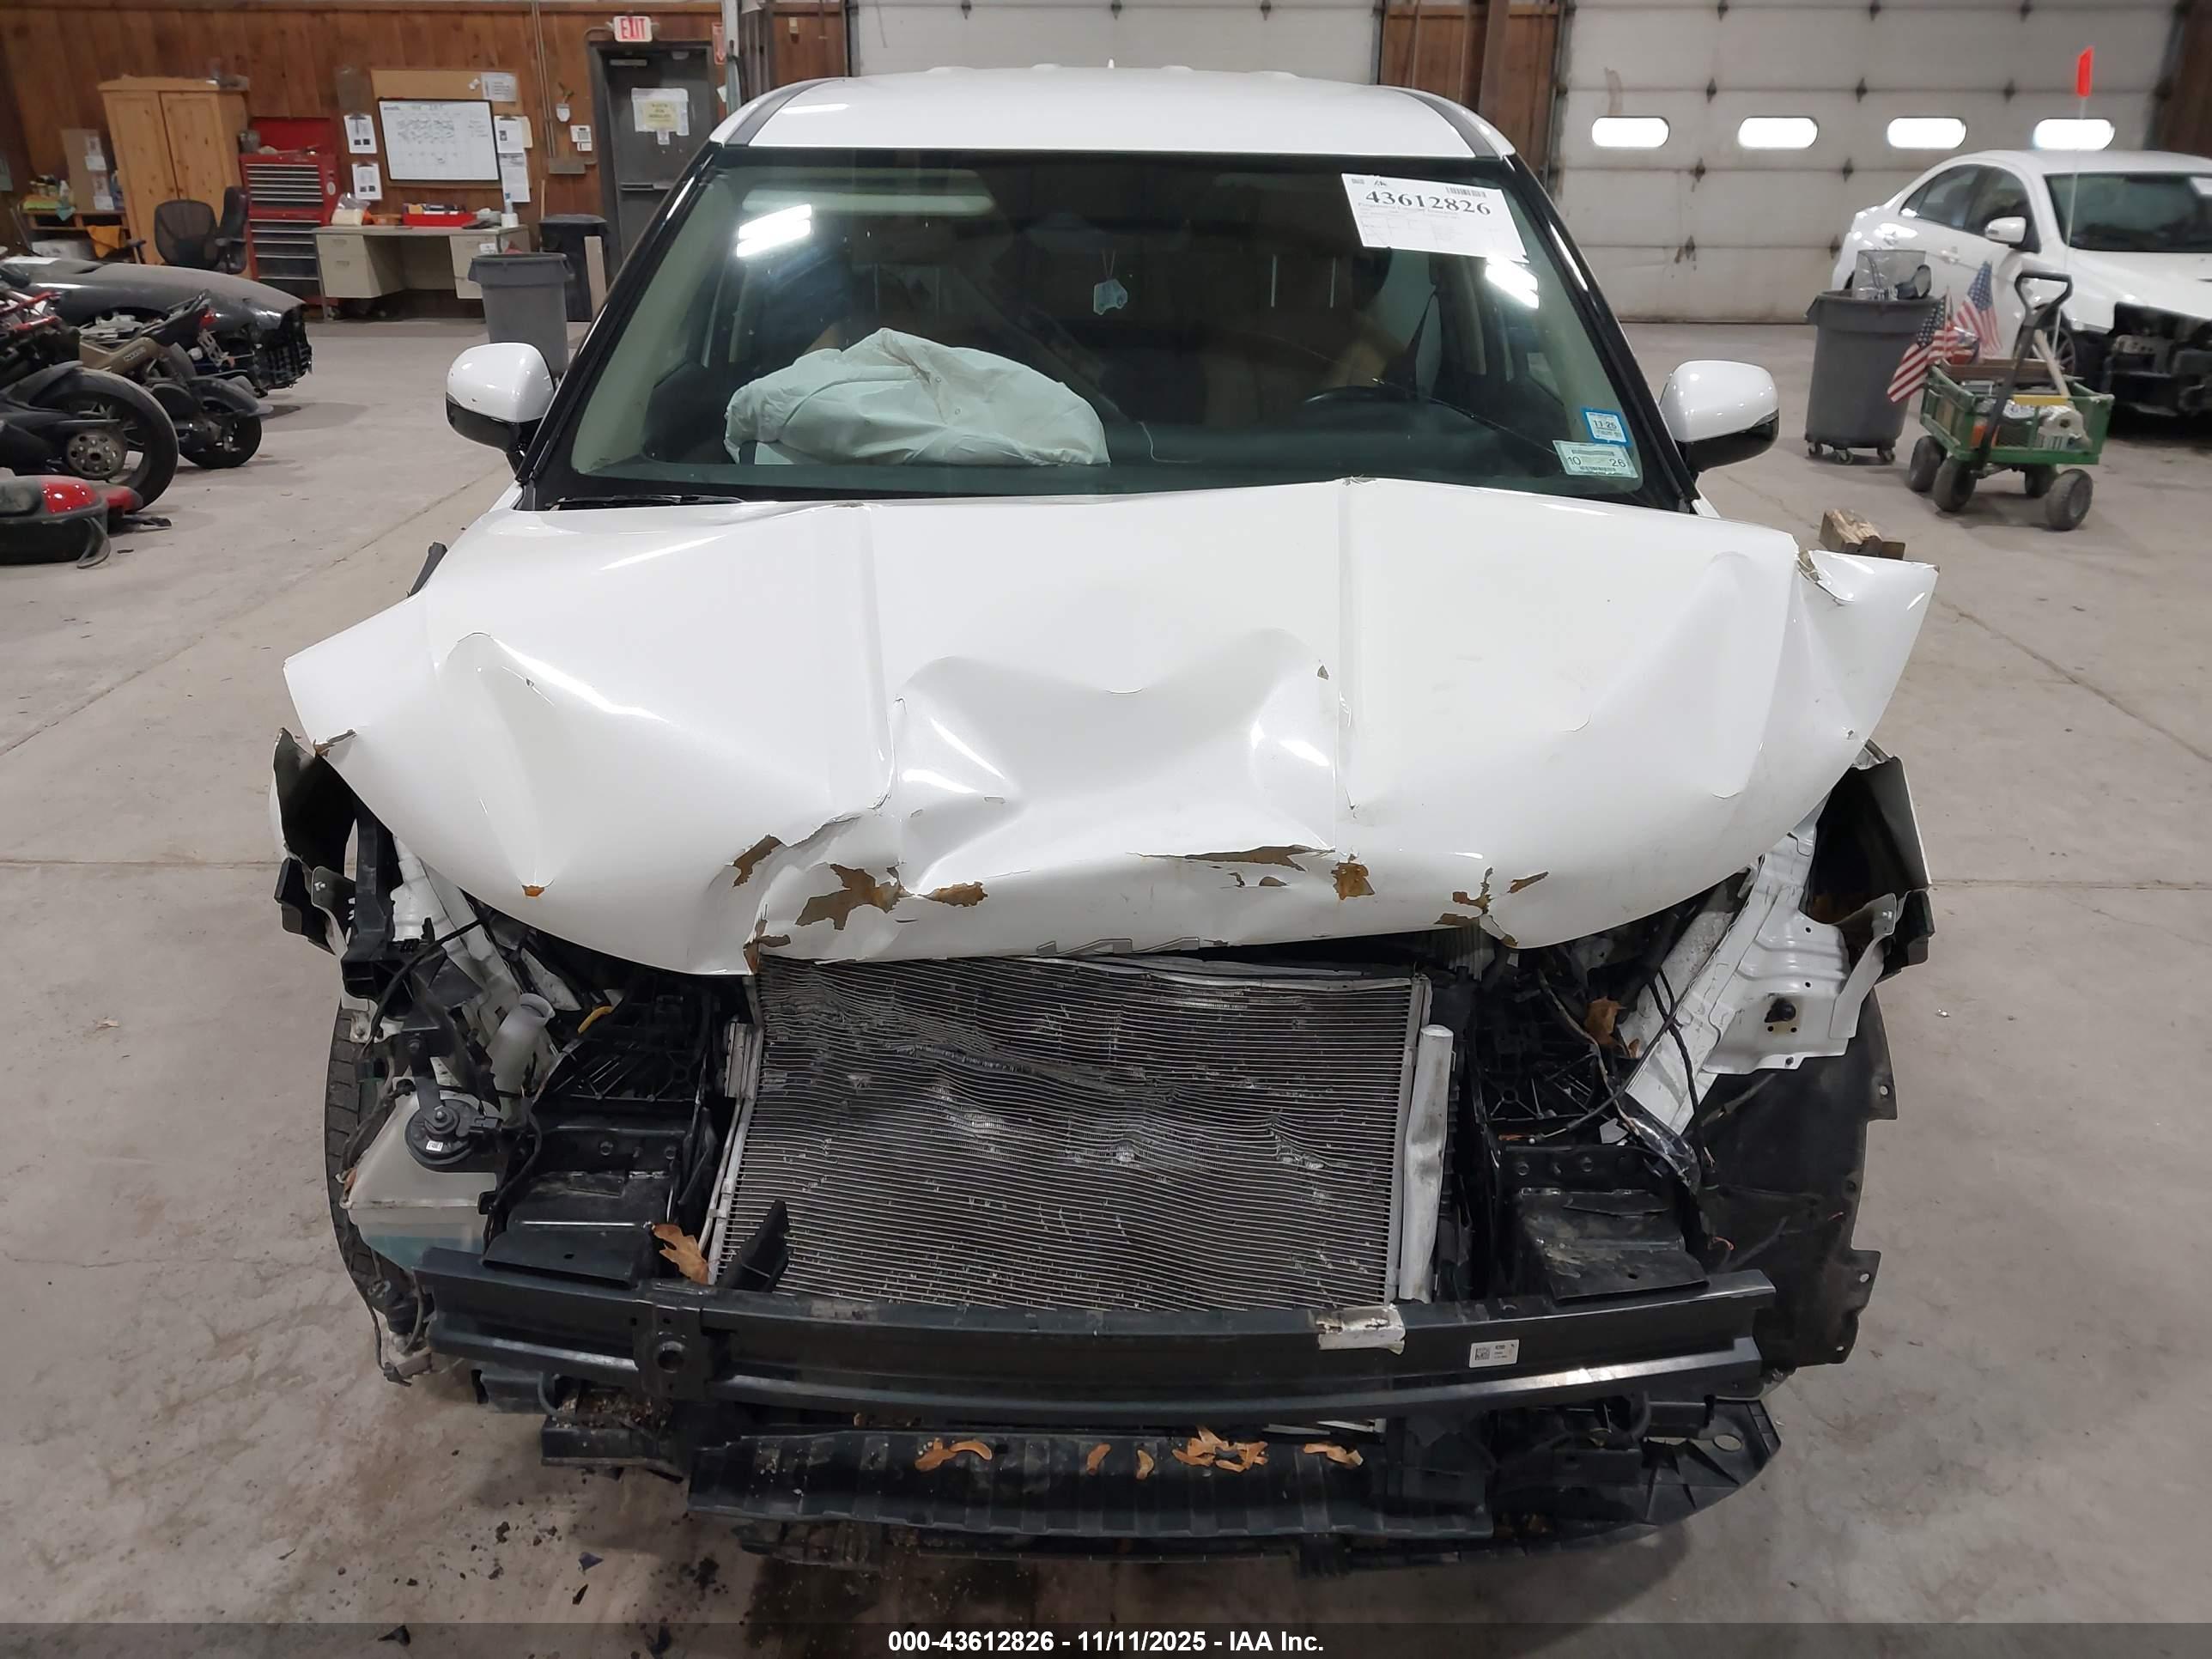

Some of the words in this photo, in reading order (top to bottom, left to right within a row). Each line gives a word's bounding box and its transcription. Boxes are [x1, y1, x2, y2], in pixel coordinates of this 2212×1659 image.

[620, 18, 646, 40] EXIT
[1365, 190, 1492, 216] 43612826
[1567, 456, 1582, 465] 10
[1609, 458, 1626, 468] 26
